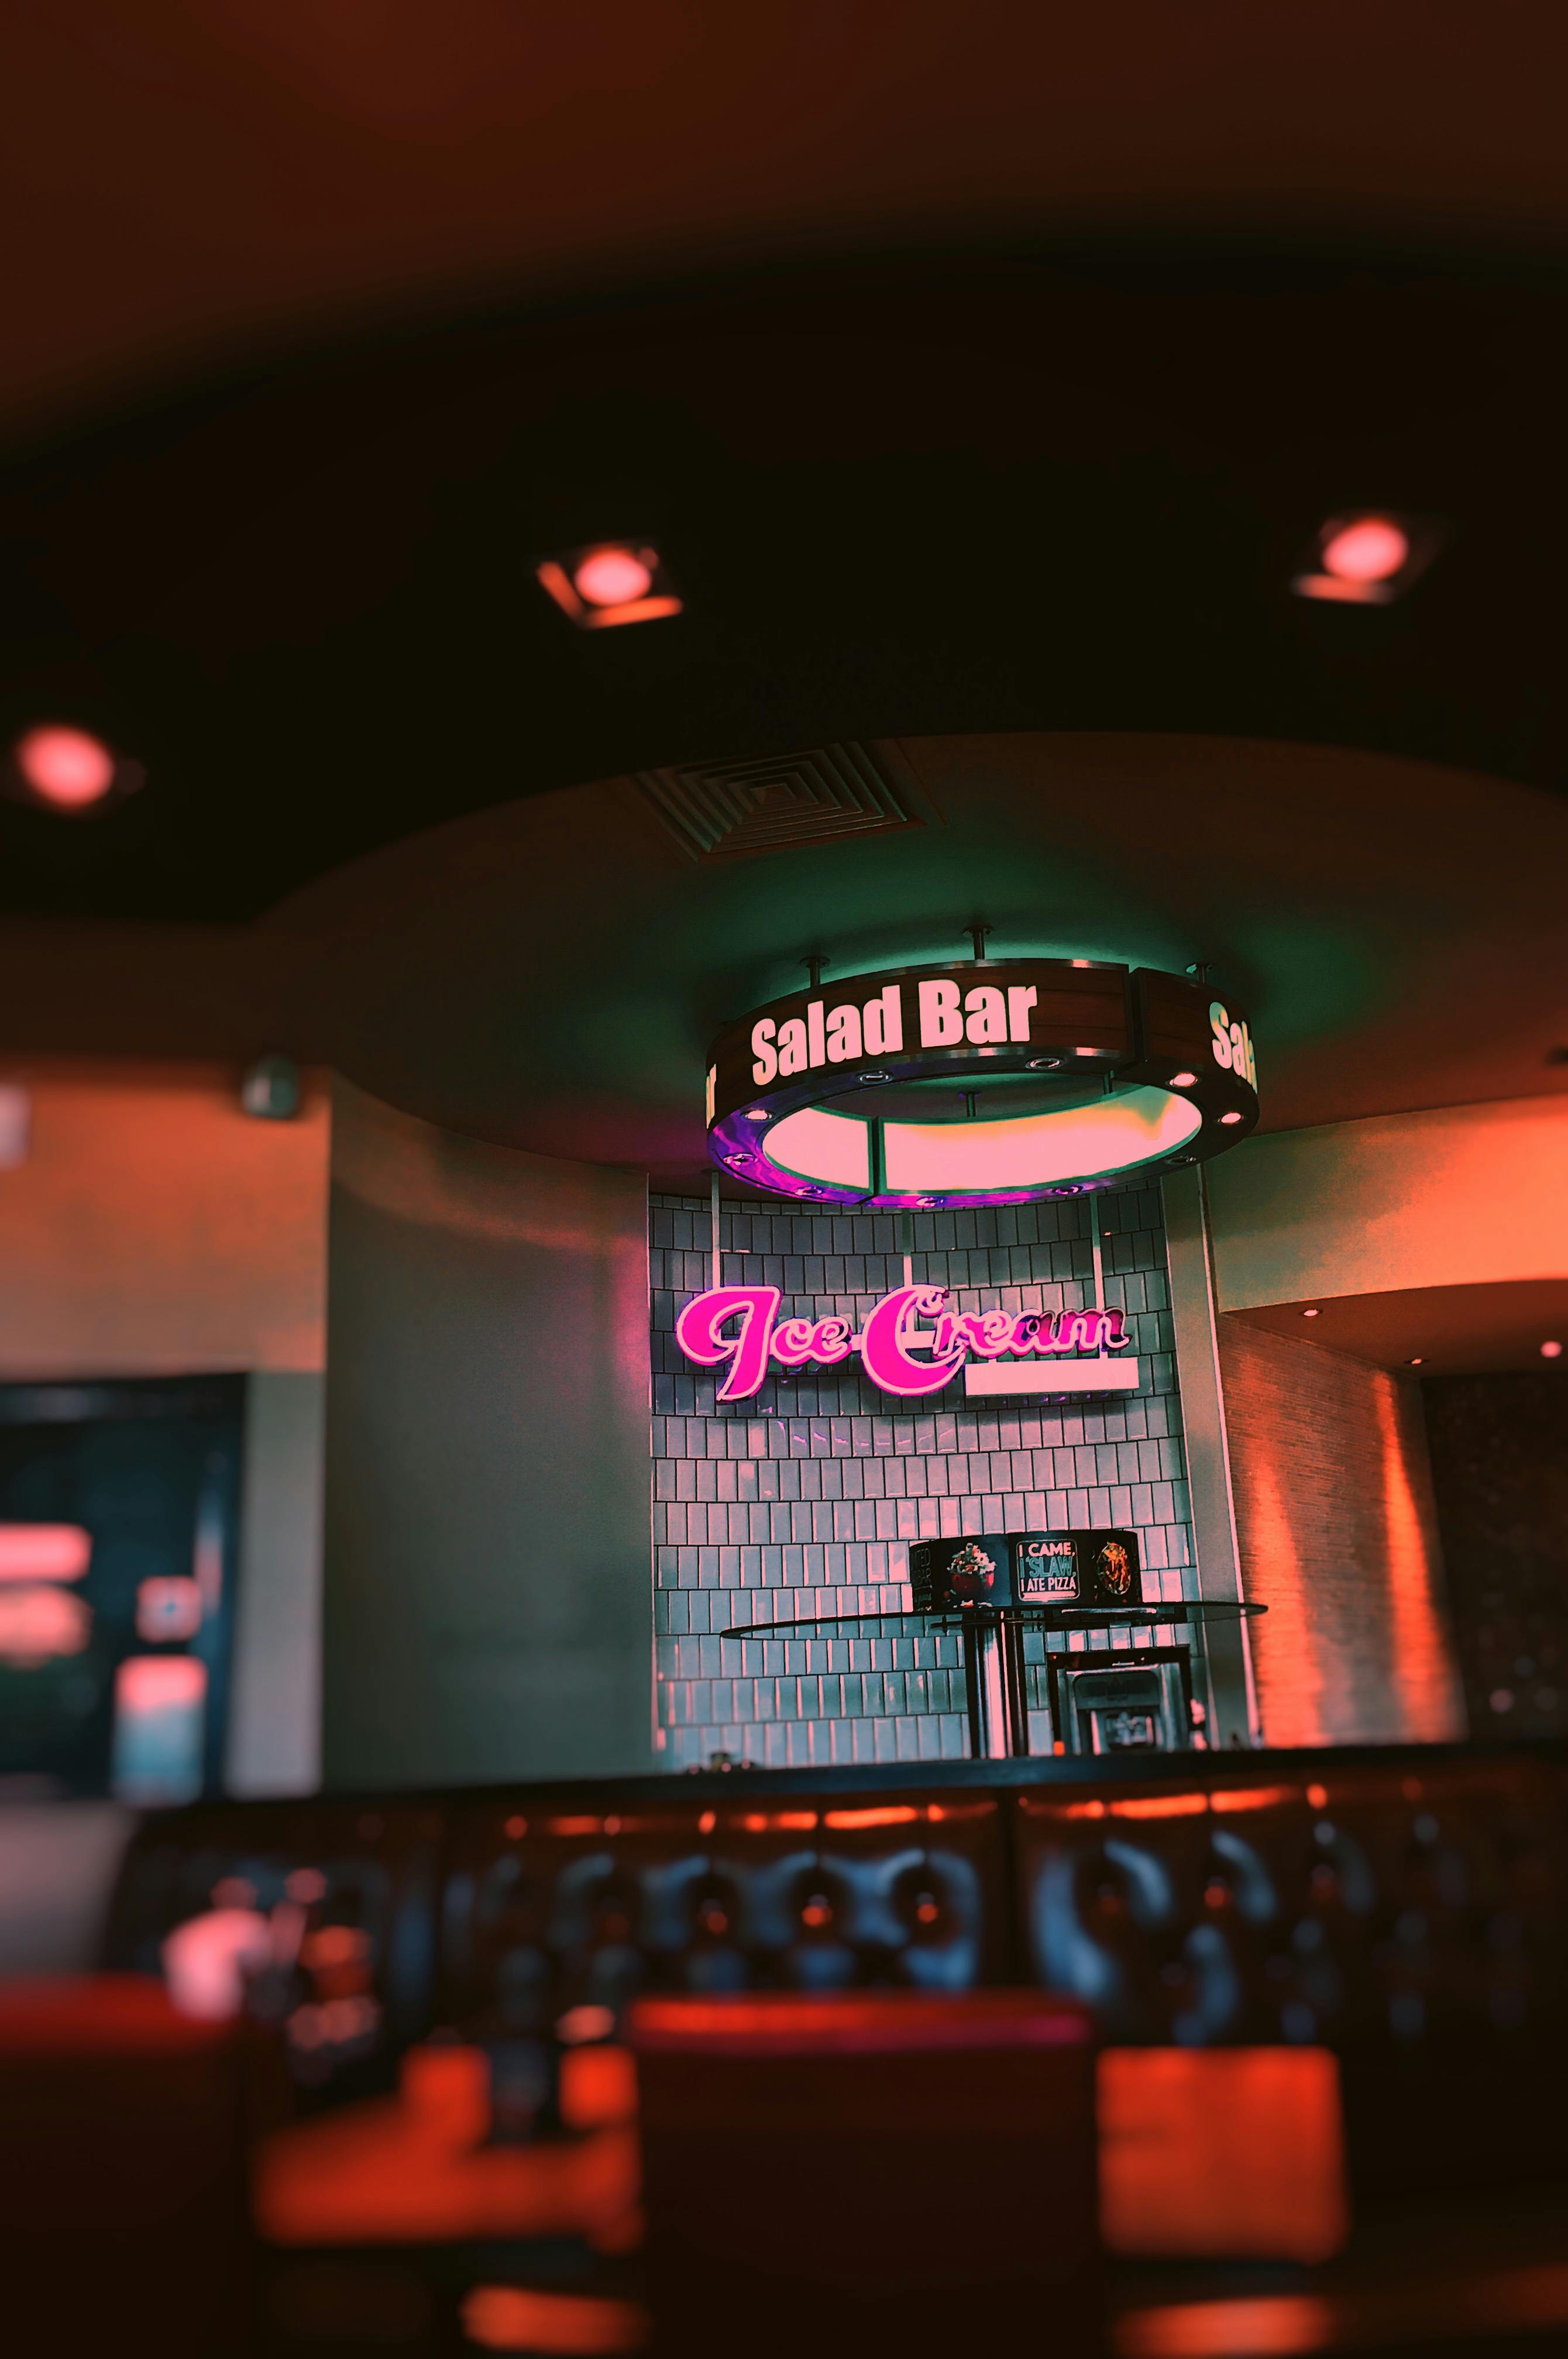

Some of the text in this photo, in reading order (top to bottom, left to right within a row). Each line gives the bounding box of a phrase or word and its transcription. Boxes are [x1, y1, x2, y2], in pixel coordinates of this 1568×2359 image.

[751, 979, 1038, 1086] Salad Bar
[676, 1283, 1134, 1402] Ice Cream
[1019, 1542, 1075, 1557] I CAME,
[1019, 1558, 1024, 1578] I
[1020, 1576, 1077, 1592] I ATE PIZZA
